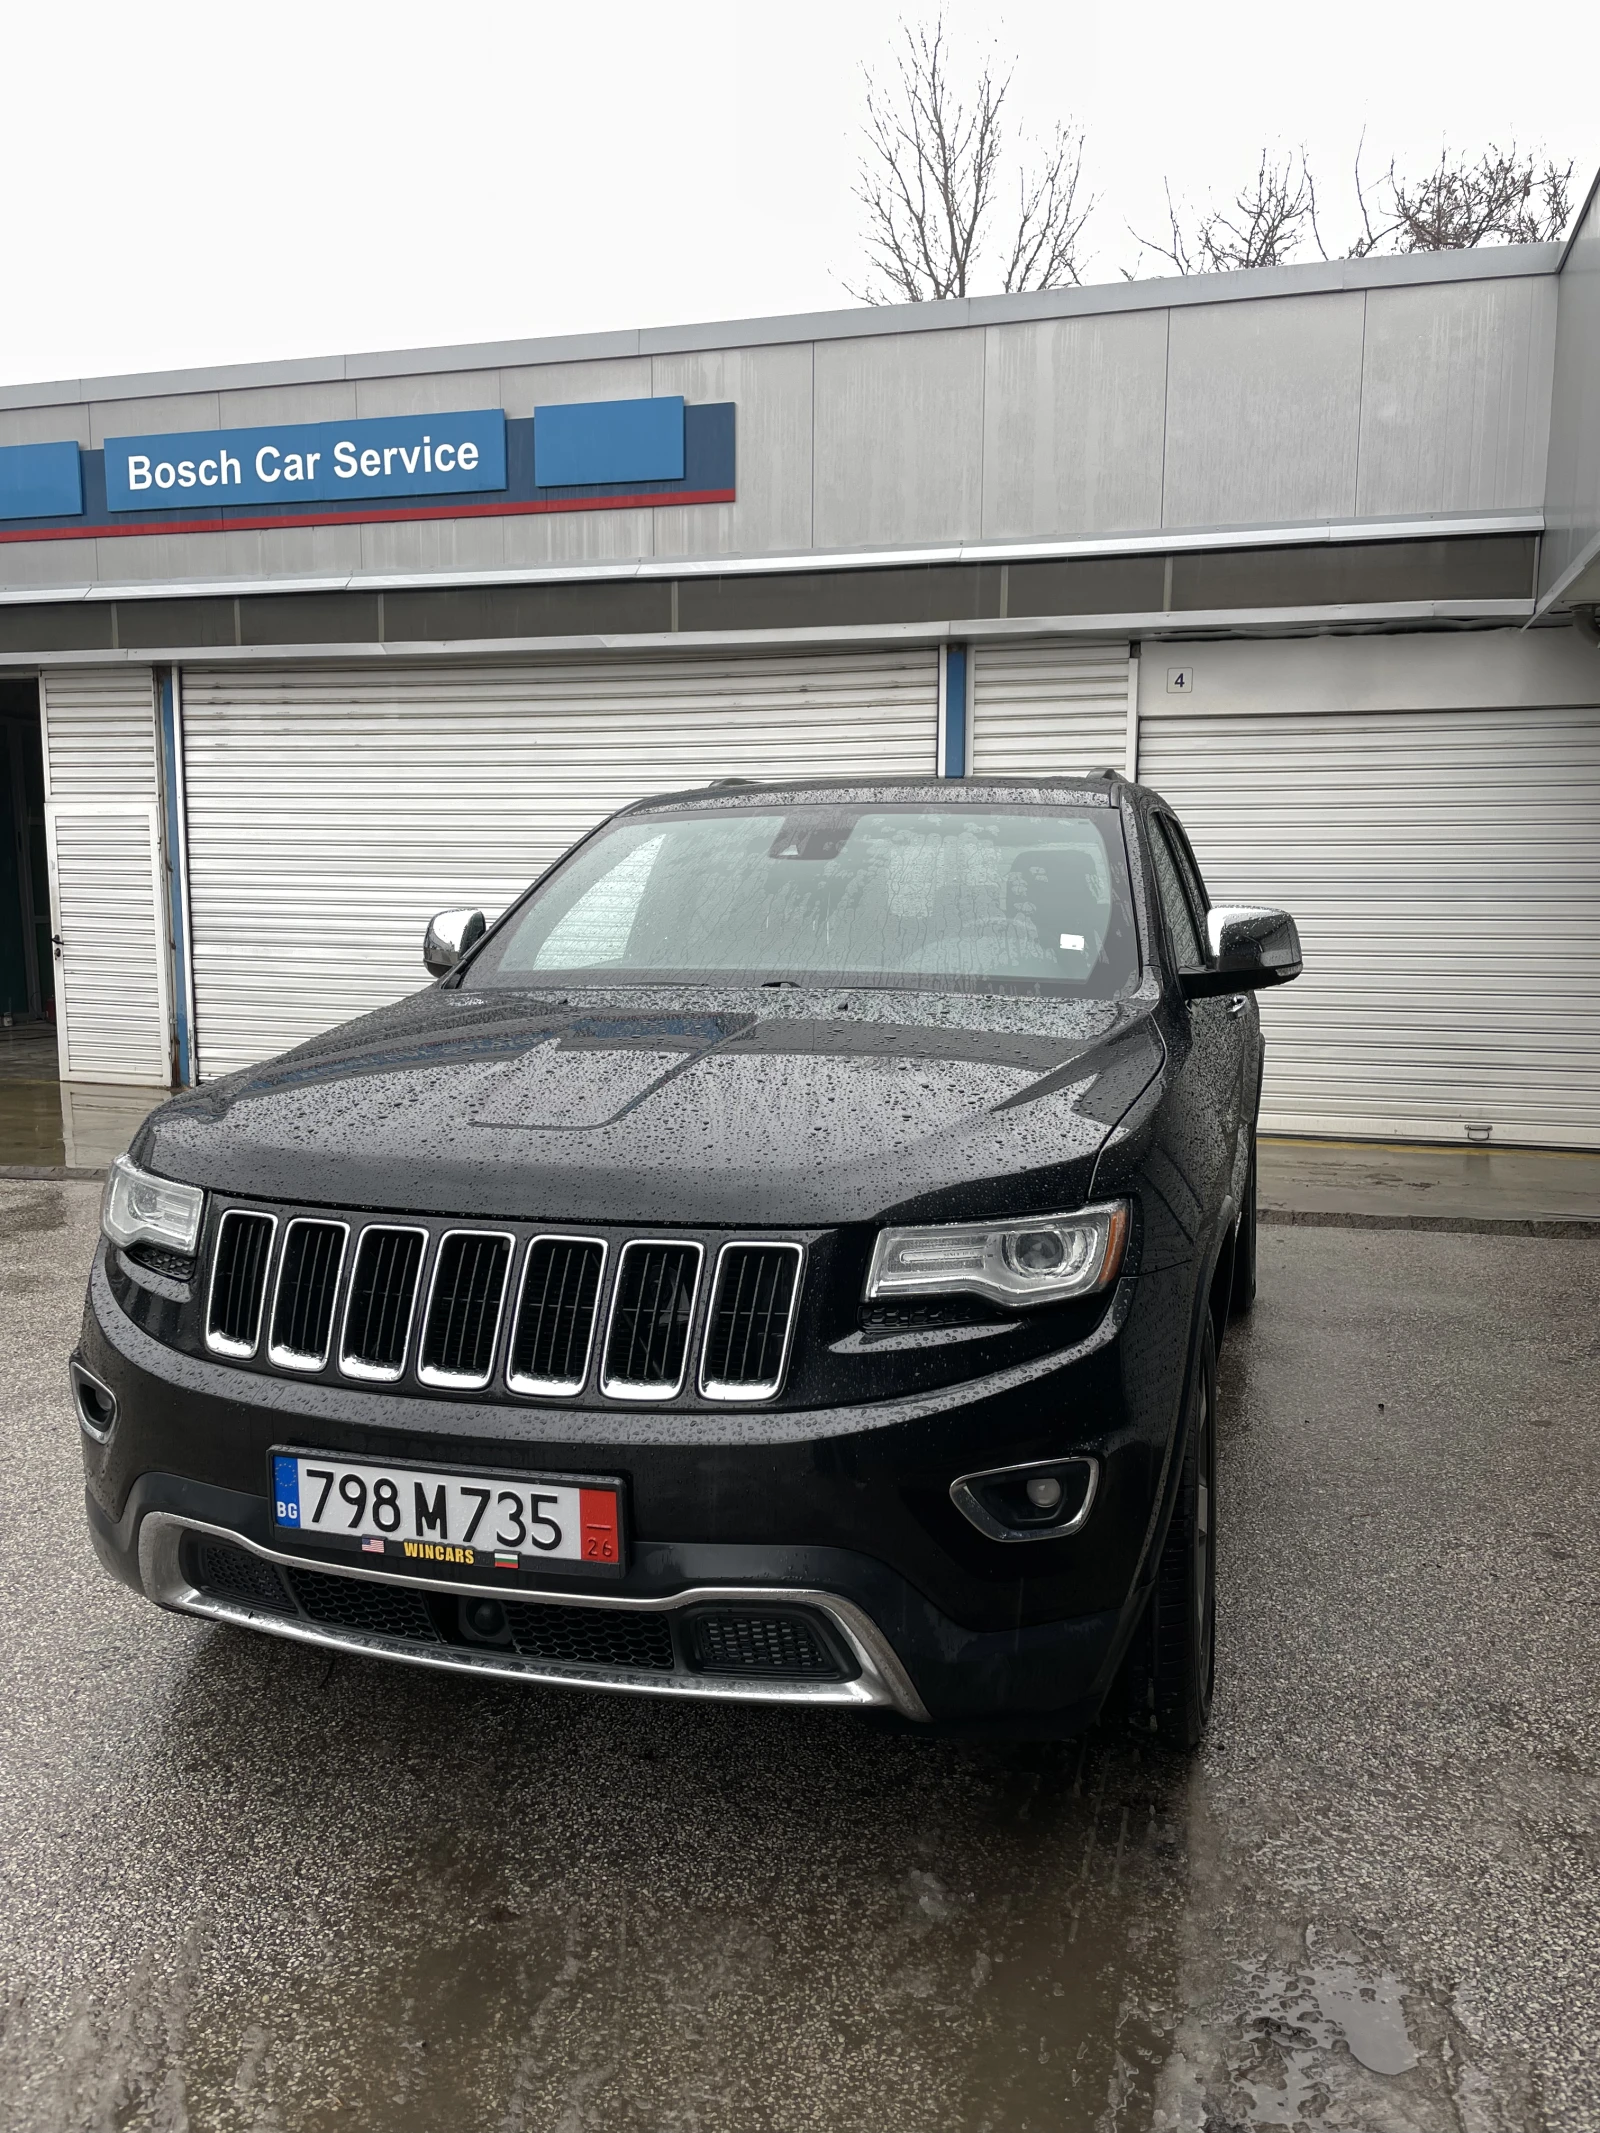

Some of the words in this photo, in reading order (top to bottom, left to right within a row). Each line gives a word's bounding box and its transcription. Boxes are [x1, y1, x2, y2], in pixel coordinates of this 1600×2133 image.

[128, 449, 242, 490] Bosch
[255, 446, 321, 483] Car
[333, 435, 479, 479] Service
[1174, 672, 1185, 688] 4
[276, 1501, 298, 1519] BG
[403, 1542, 475, 1565] WINCARS
[587, 1537, 613, 1558] 26
